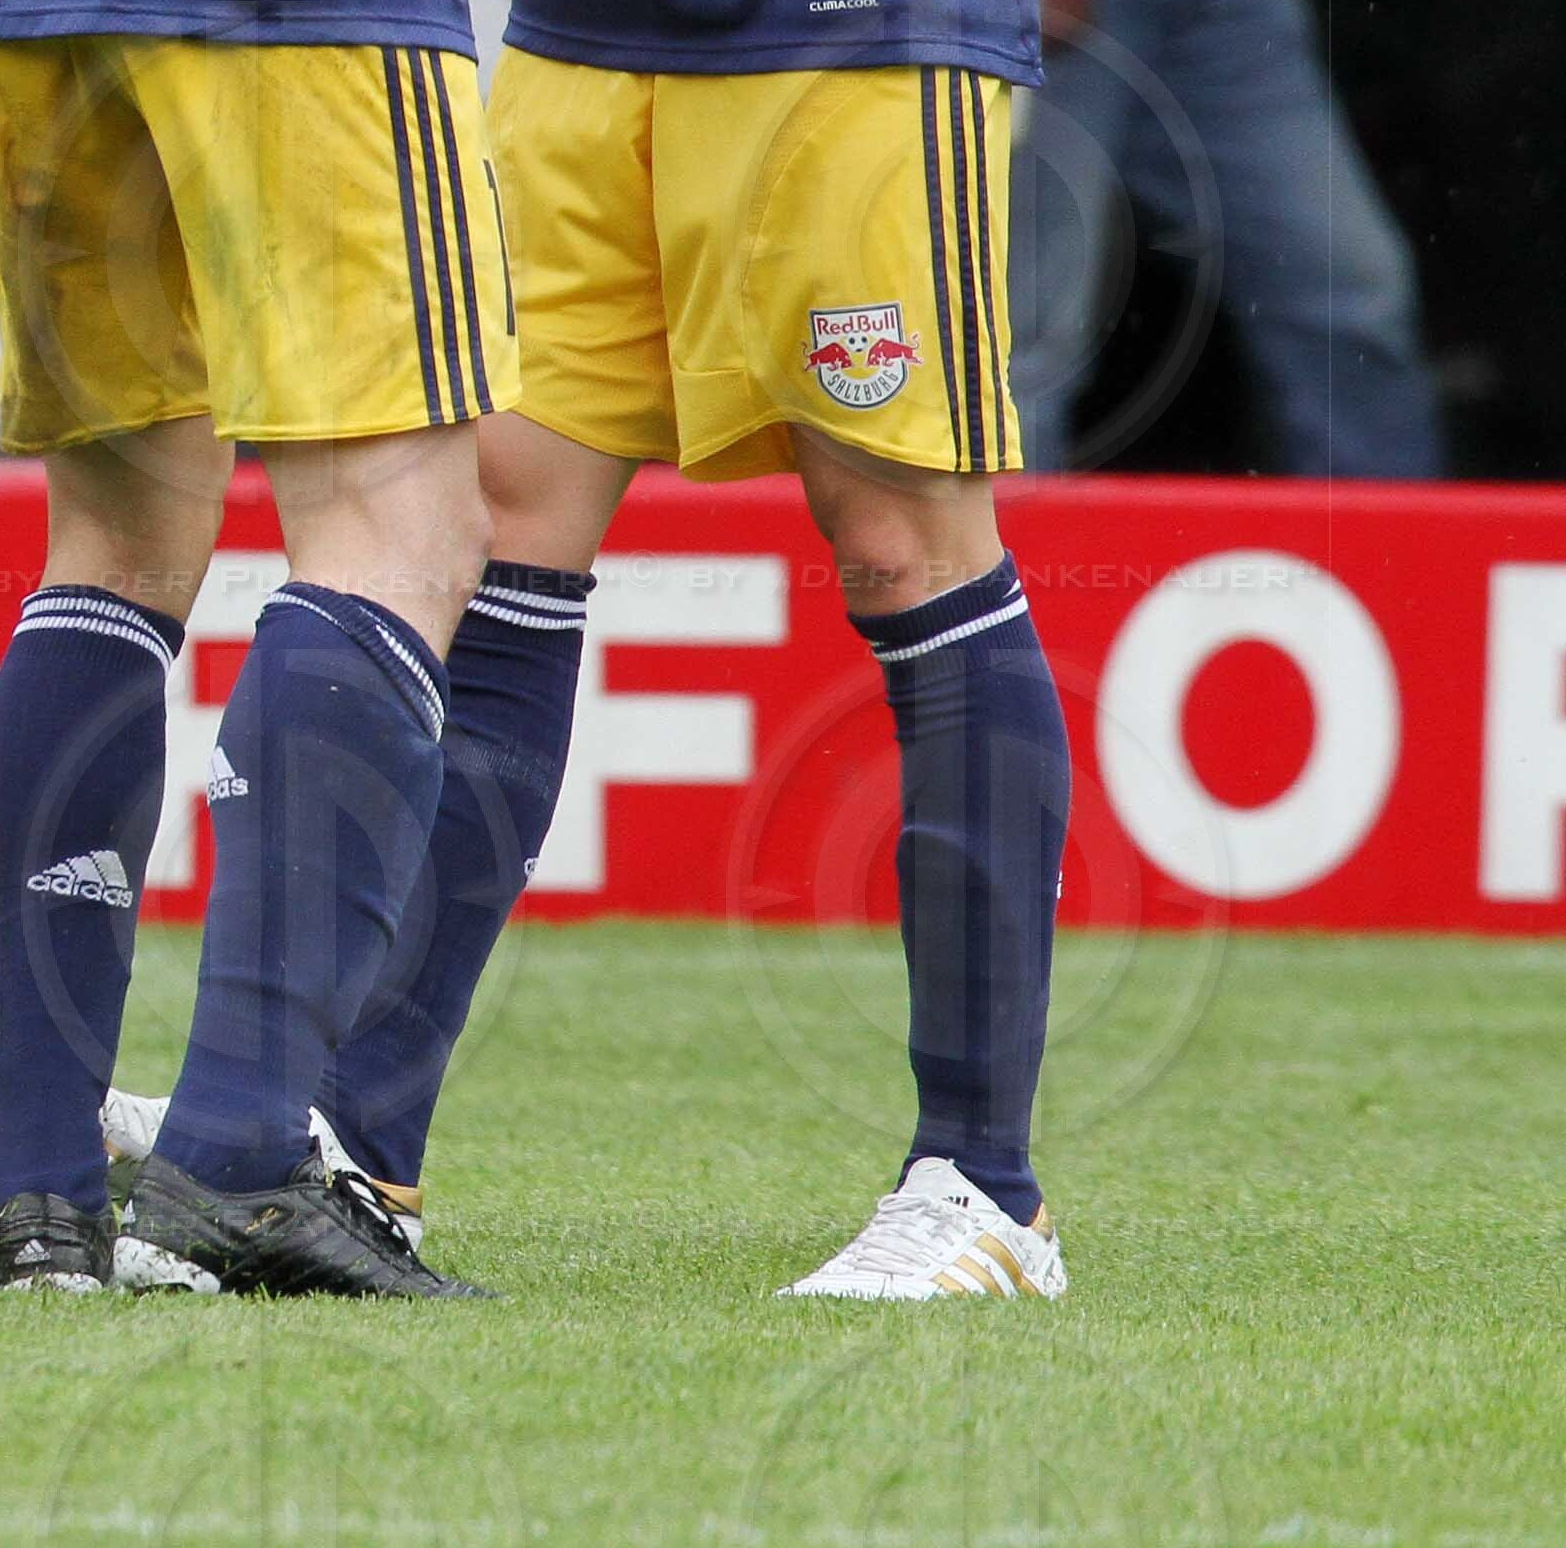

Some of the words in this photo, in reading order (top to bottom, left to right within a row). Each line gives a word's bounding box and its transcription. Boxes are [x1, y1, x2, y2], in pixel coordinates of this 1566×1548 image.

[816, 316, 855, 335] Red
[858, 310, 895, 332] Bull
[827, 369, 900, 402] SALZBURG
[26, 874, 133, 909] adidas
